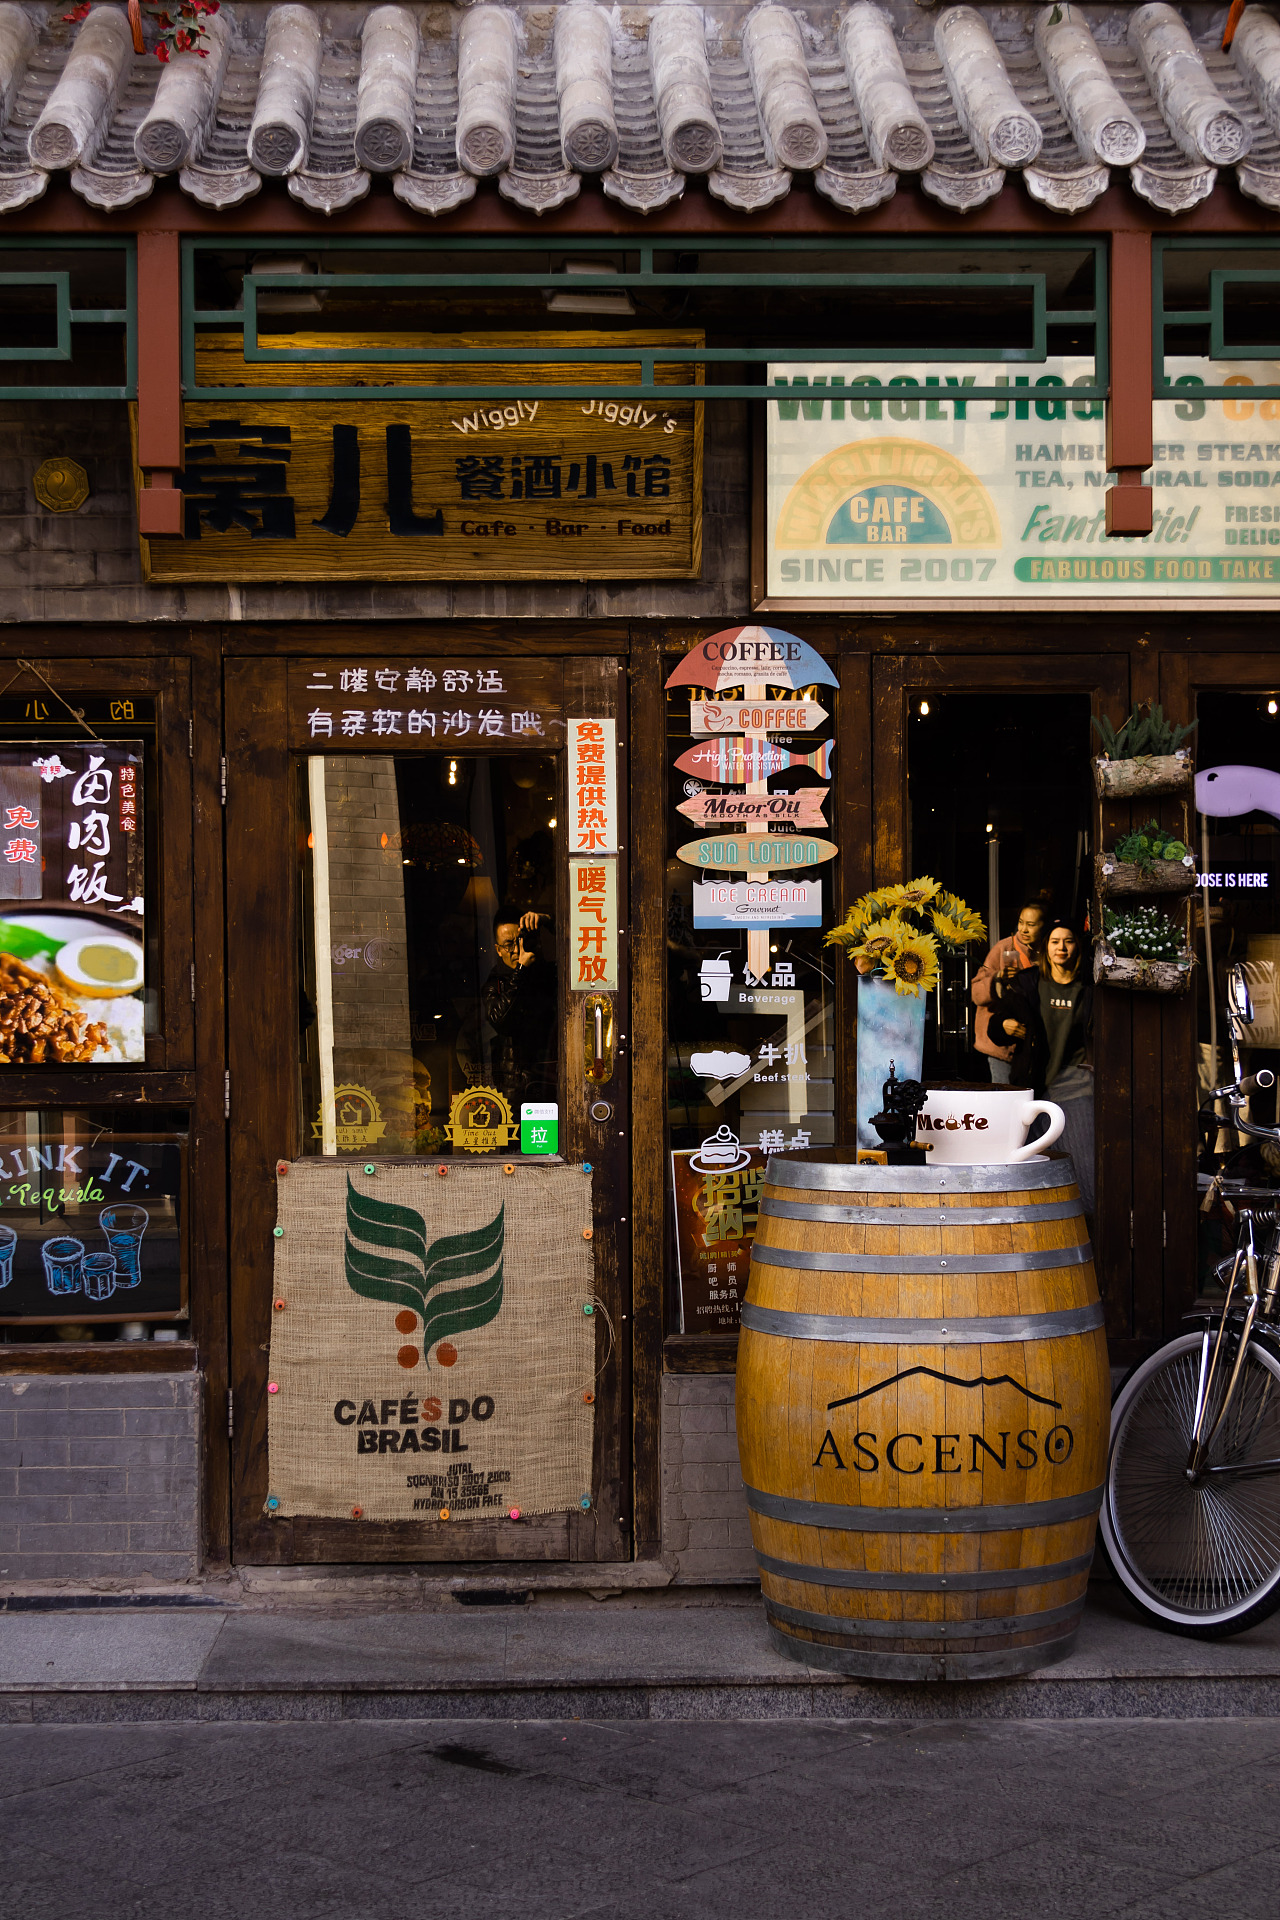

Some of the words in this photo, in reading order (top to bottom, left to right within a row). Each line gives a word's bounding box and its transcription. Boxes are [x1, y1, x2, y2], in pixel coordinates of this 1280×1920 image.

[774, 375, 976, 422] WIGGLY
[451, 400, 539, 434] Wiggly
[455, 454, 672, 500] 餐酒小馆
[1015, 470, 1074, 490] TEA,
[1084, 470, 1208, 487] NAURAL
[787, 447, 883, 541] WIGGLY
[850, 496, 925, 524] CAFE
[460, 519, 517, 537] Cafe
[545, 519, 590, 537] Bar
[617, 519, 673, 537] Food
[866, 525, 907, 543] BAR
[780, 558, 884, 582] SINCE
[900, 558, 997, 582] 2007
[1030, 559, 1147, 580] FABULOUS
[1153, 560, 1212, 580] FOOD
[1219, 560, 1274, 579] TAKE
[702, 641, 801, 662] COFFEE
[306, 667, 507, 694] 二楼安静舒适
[738, 708, 807, 729] COFFEE
[692, 747, 728, 767] High
[727, 747, 787, 762] Protection
[722, 761, 744, 770] WATER
[747, 761, 784, 770] RESISTANT
[576, 721, 607, 850] 免费提供热水
[120, 767, 136, 831] 特色美食
[704, 798, 767, 814] Motor
[767, 798, 801, 814] Oil
[4, 805, 40, 864] 免费
[66, 754, 124, 905] 卤肉饭
[699, 842, 738, 864] SUN
[749, 841, 819, 864] LOTION
[1225, 873, 1236, 887] IS
[1238, 873, 1268, 887] HERE
[710, 887, 738, 903] ICE
[746, 887, 808, 903] CREAM
[736, 903, 782, 913] Gourmet
[577, 866, 608, 983] 暖气开放
[738, 993, 796, 1005] Beverage
[758, 1043, 808, 1067] 牛扒
[753, 1072, 779, 1082] Beef
[780, 1072, 811, 1082] steak
[462, 1129, 479, 1137] Time
[482, 1129, 497, 1137] Out
[462, 1137, 498, 1146] 五星推荐
[530, 1126, 548, 1144] 拉
[9, 1176, 105, 1212] Tequila
[709, 1288, 739, 1301] 服务员
[334, 1391, 442, 1425] CAFÉS
[448, 1395, 495, 1425] DO
[357, 1427, 469, 1454] BRASIL
[811, 1424, 1074, 1475] ASCENSO
[446, 1463, 474, 1476] JUTAL
[430, 1486, 444, 1498] AN
